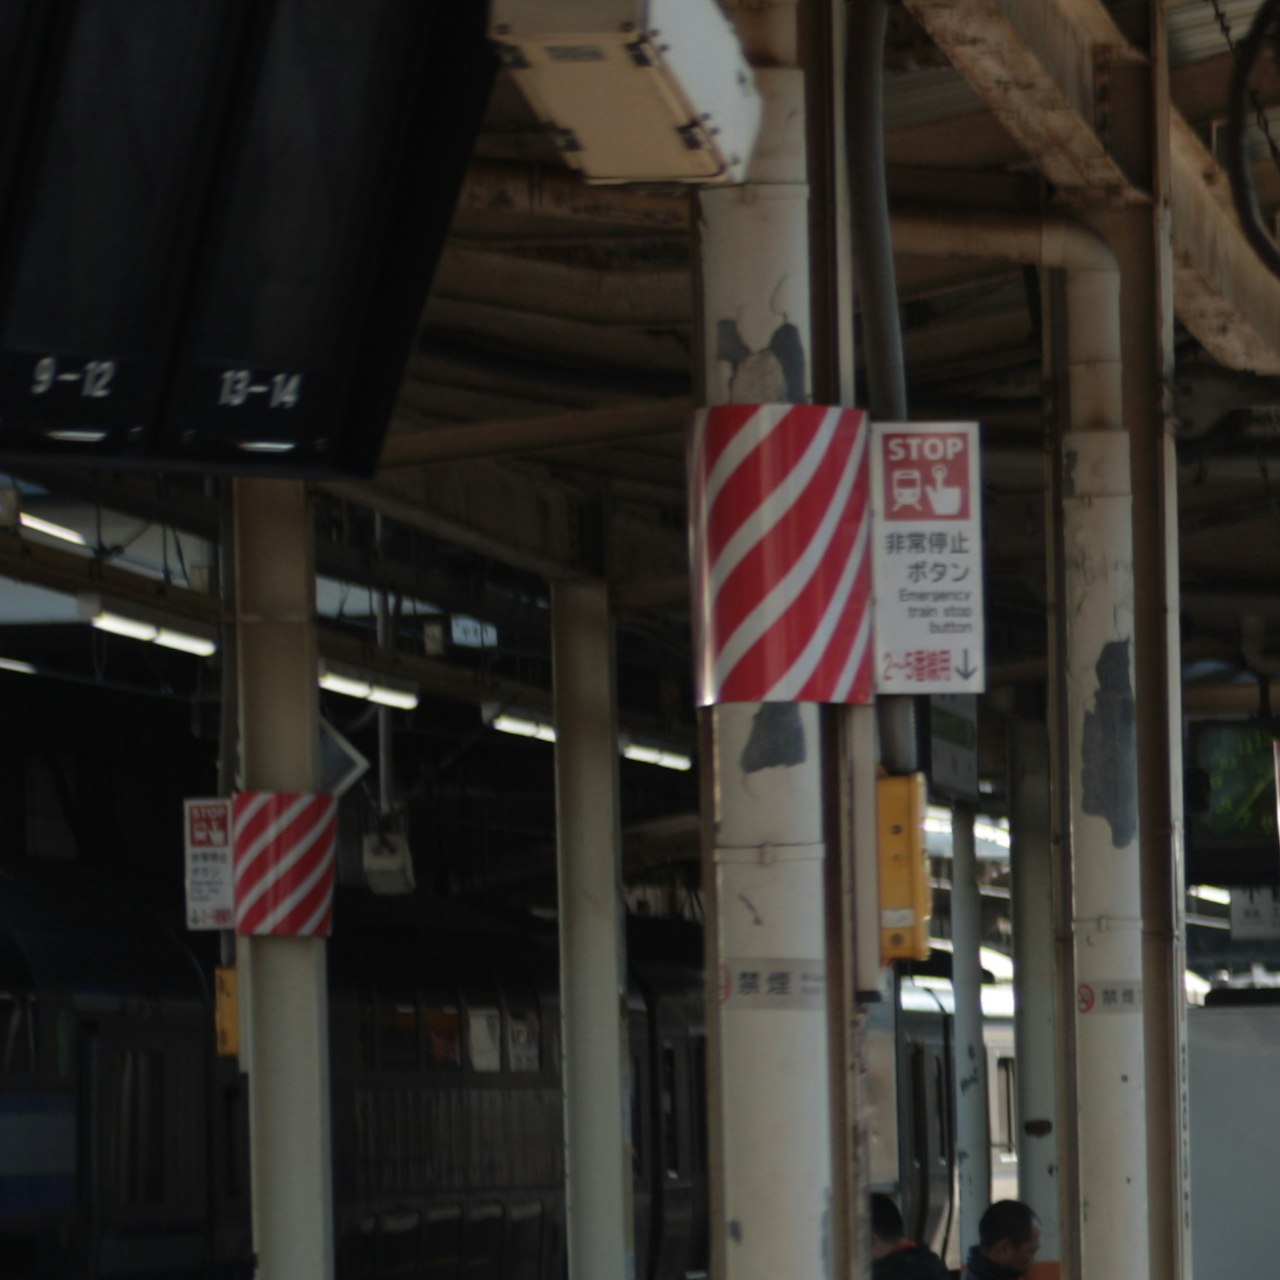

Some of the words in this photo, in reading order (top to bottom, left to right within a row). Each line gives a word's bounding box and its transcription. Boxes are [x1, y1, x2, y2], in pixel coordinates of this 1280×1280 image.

[31, 356, 116, 398] 9-12
[217, 368, 302, 410] 13-14
[887, 437, 965, 461] STOP
[885, 531, 970, 555] 非常停止
[908, 560, 969, 583] ボタン
[898, 588, 971, 602] Emergency
[908, 606, 937, 618] train
[943, 606, 972, 619] stop
[929, 622, 972, 634] button
